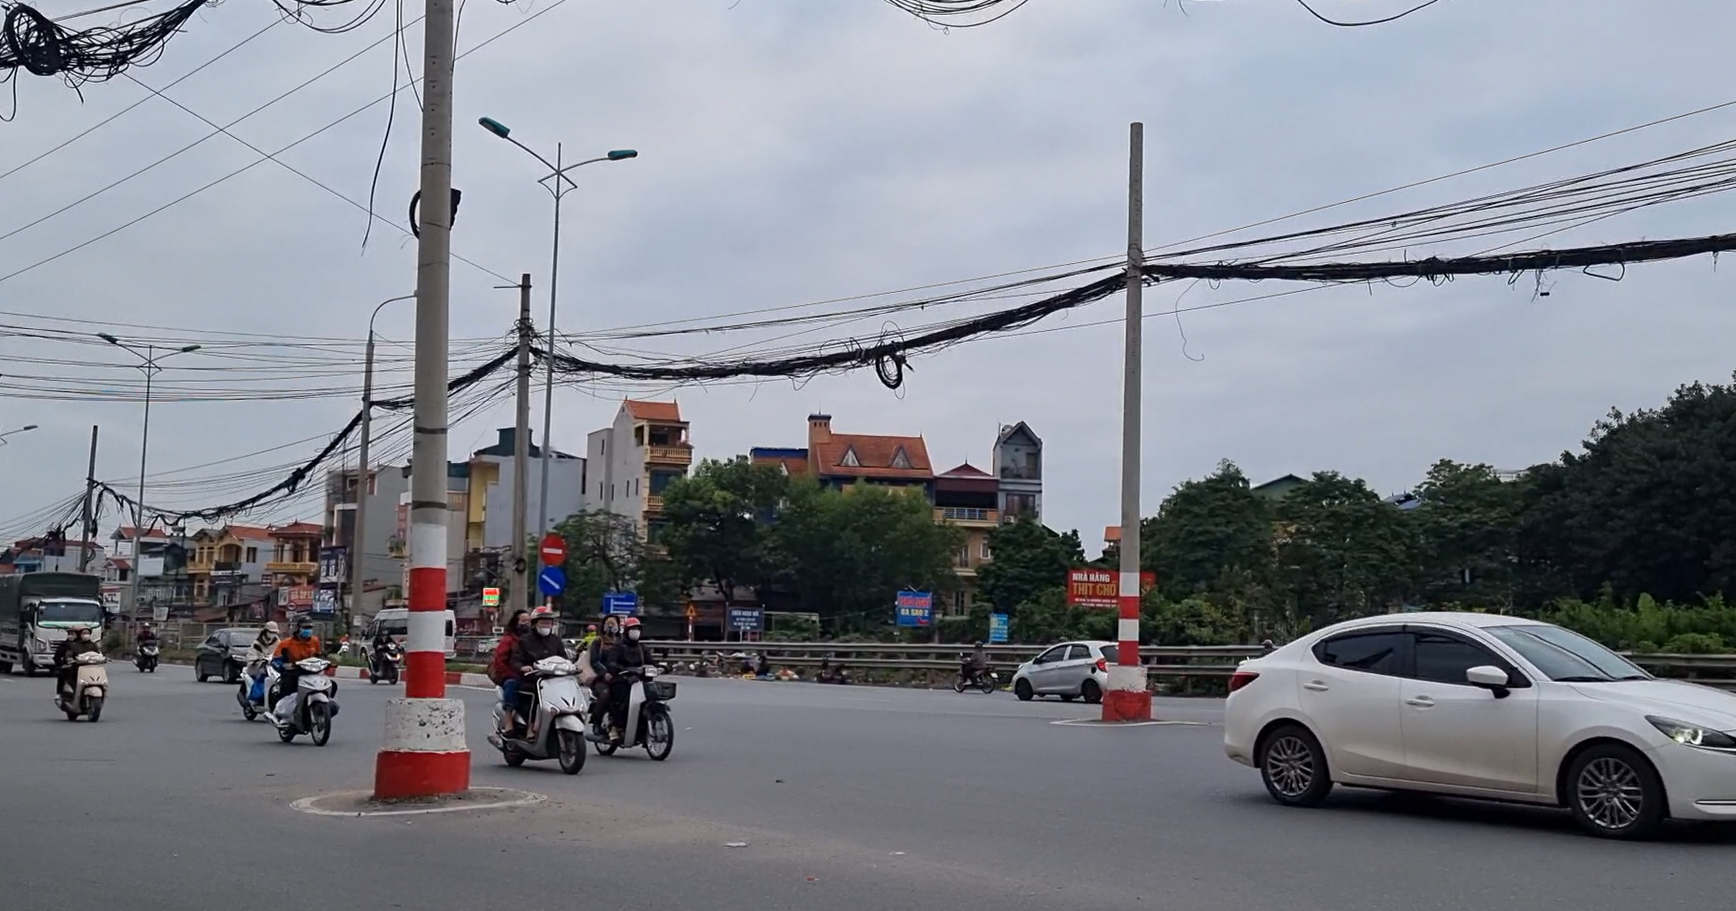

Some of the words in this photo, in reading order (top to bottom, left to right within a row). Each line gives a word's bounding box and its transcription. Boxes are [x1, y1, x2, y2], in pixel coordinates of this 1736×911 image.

[1072, 571, 1088, 582] NHÀ
[1089, 571, 1110, 583] HÀNG
[1073, 583, 1095, 598] THỊT
